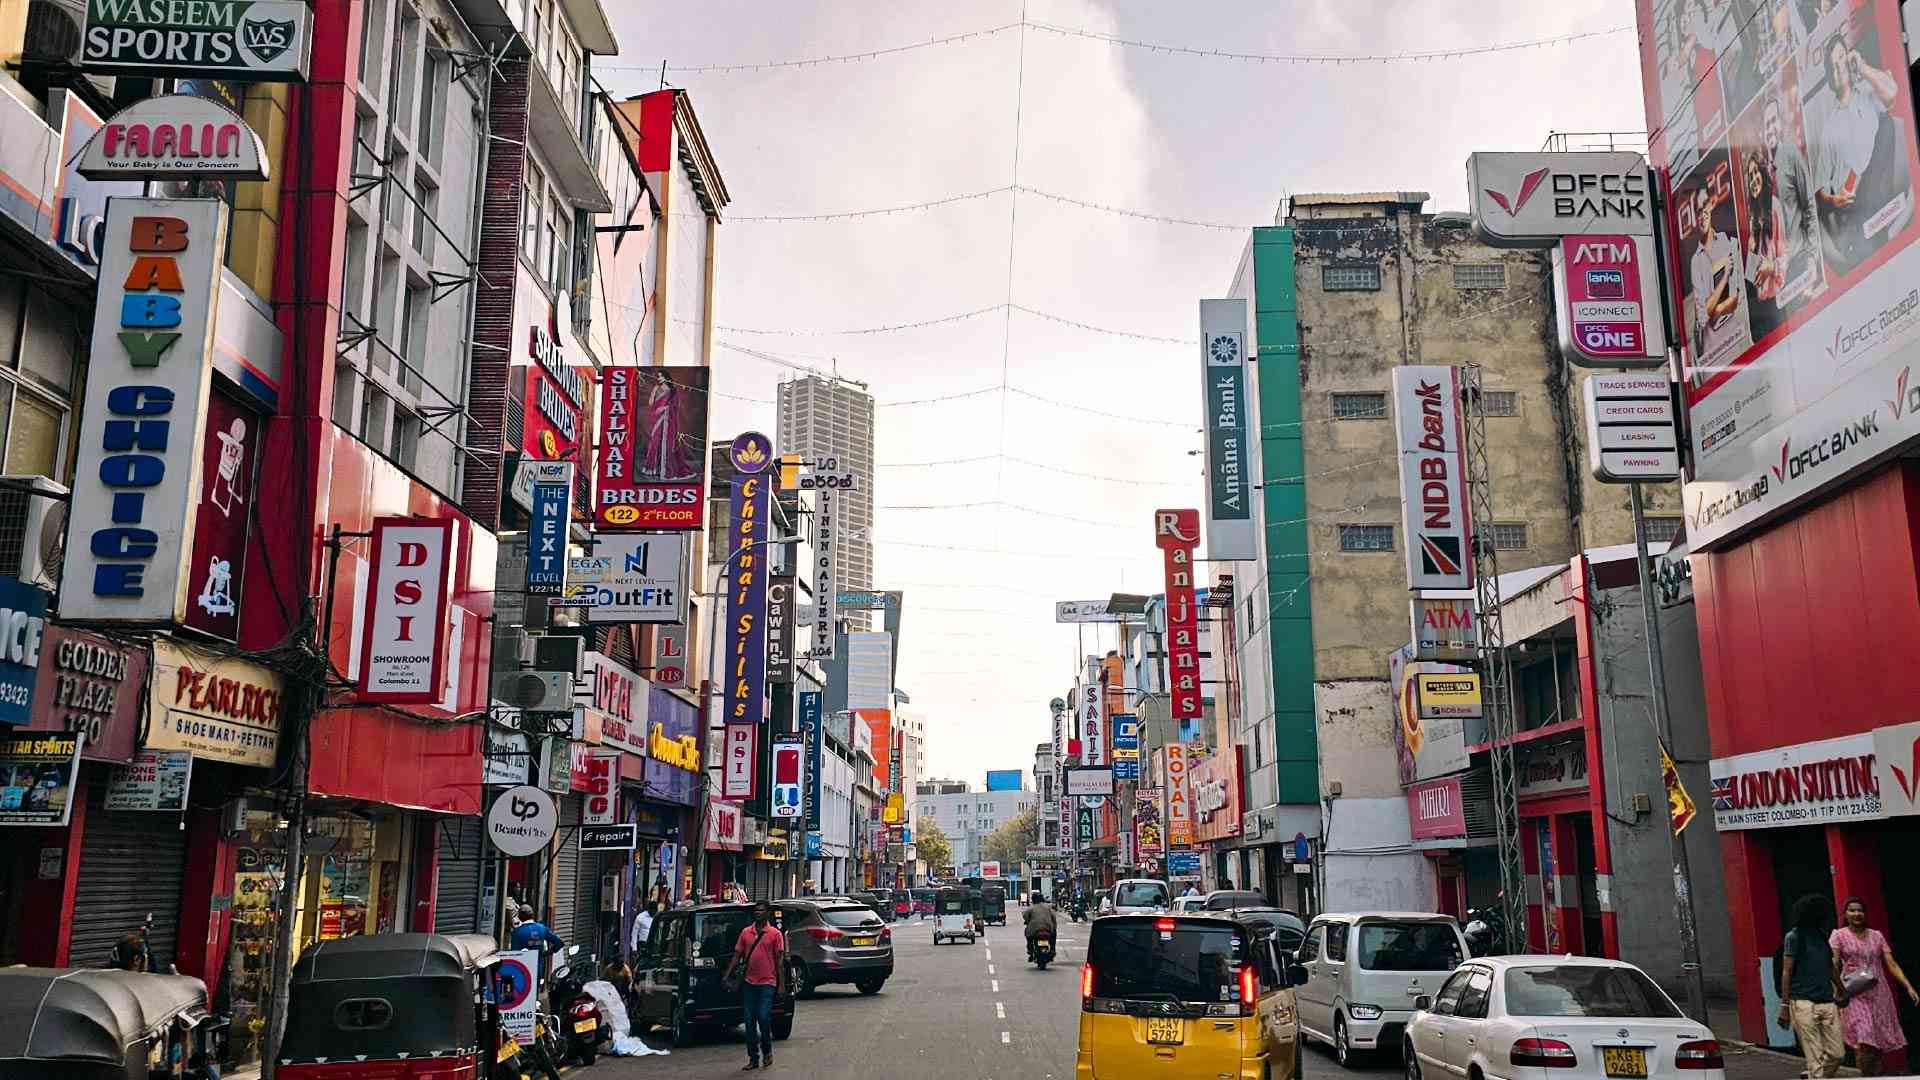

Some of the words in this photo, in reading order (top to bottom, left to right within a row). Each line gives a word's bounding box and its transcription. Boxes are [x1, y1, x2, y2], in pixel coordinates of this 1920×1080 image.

[95, 0, 235, 27] WASEEM
[86, 26, 232, 64] SPORTS
[246, 24, 287, 48] WS
[107, 161, 130, 169] Your
[133, 161, 160, 171] Baby
[197, 161, 240, 169] Concern
[1551, 174, 1644, 196] DFCC
[1553, 197, 1646, 219] BANK
[1572, 243, 1632, 265] ATM
[1588, 272, 1621, 283] lanka
[117, 215, 190, 369] BABY
[1584, 324, 1609, 332] DFCC
[1585, 332, 1636, 348] ONE
[536, 326, 583, 410] SHALWAR
[1627, 381, 1666, 389] SERVICES
[541, 375, 577, 442] BRIDES
[1216, 375, 1237, 428] Bank
[605, 370, 631, 478] SHALWAR
[1414, 378, 1447, 454] bank
[1789, 438, 1830, 480] DFCC
[1831, 409, 1880, 457] BANK
[1623, 459, 1660, 467] PAWNING
[90, 385, 176, 597] CHOICE
[538, 487, 565, 499] THE
[602, 488, 698, 504] BRIDES
[1420, 457, 1451, 530] NDB
[609, 509, 634, 520] 122
[656, 511, 693, 520] FLOOR
[819, 490, 832, 551] LINEN
[540, 502, 558, 571] NEXT
[738, 478, 759, 605] Chennai
[529, 573, 562, 583] LEVEL
[529, 584, 561, 594] 122/14
[393, 541, 429, 642] DSI
[598, 588, 673, 606] OutFit
[818, 557, 829, 645] GALLERY
[1157, 512, 1201, 714] Ranjanas
[1422, 607, 1472, 629] ATM
[58, 639, 130, 682] GOLDEN
[373, 655, 430, 664] SHOWROOM
[733, 613, 754, 718] Silks
[56, 671, 116, 715] PLAZA
[175, 665, 281, 729] PEARLRICH
[176, 718, 207, 737] SHOE
[33, 740, 76, 755] SPORTS
[734, 731, 748, 775] DSI
[1168, 746, 1185, 818] ROYAL
[1727, 766, 1801, 810] LONDON
[1801, 753, 1880, 803] SUITING
[1728, 814, 1745, 825] MAIN
[1745, 812, 1770, 823] STREET
[1837, 805, 1849, 815] 011
[1151, 1029, 1179, 1041] 5787
[1615, 1047, 1633, 1060] KG
[1610, 1061, 1641, 1074] 9481
